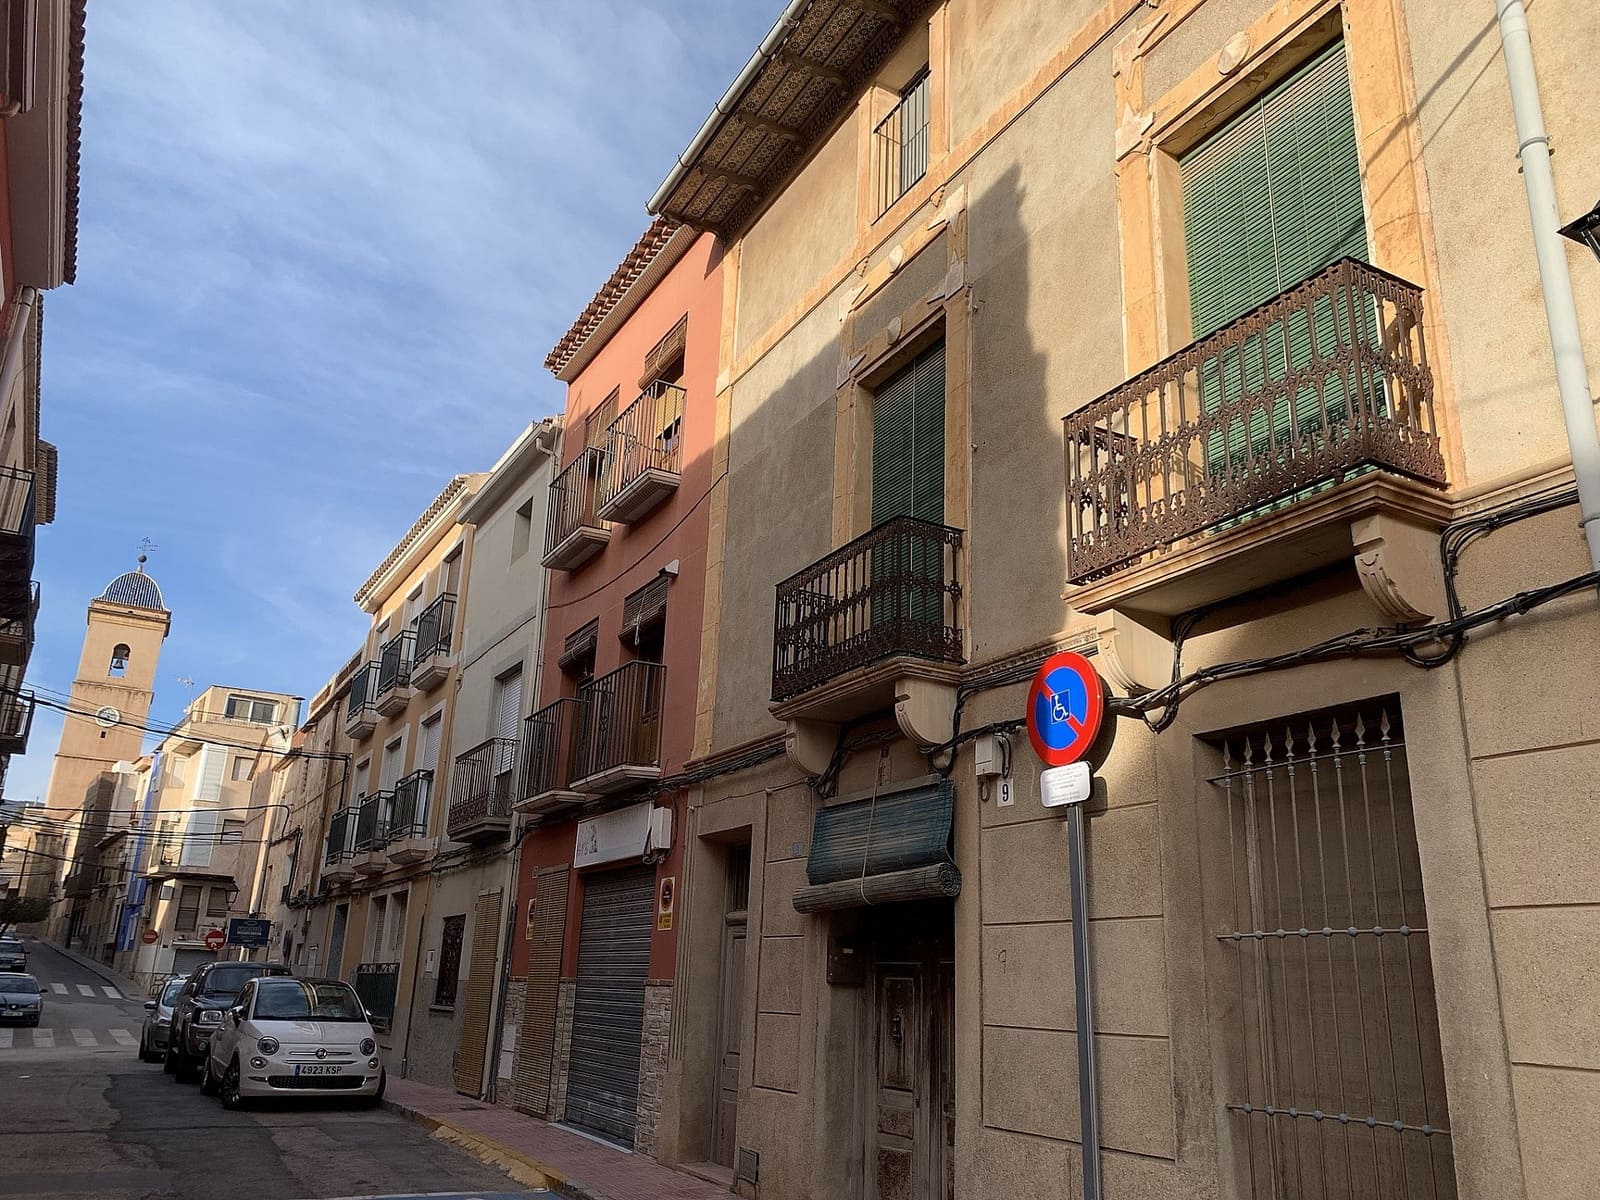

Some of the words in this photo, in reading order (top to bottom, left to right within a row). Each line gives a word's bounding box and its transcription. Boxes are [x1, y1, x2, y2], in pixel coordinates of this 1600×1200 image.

[1002, 783, 1009, 802] 9
[301, 1065, 324, 1075] 4923
[325, 1065, 343, 1075] KSP
